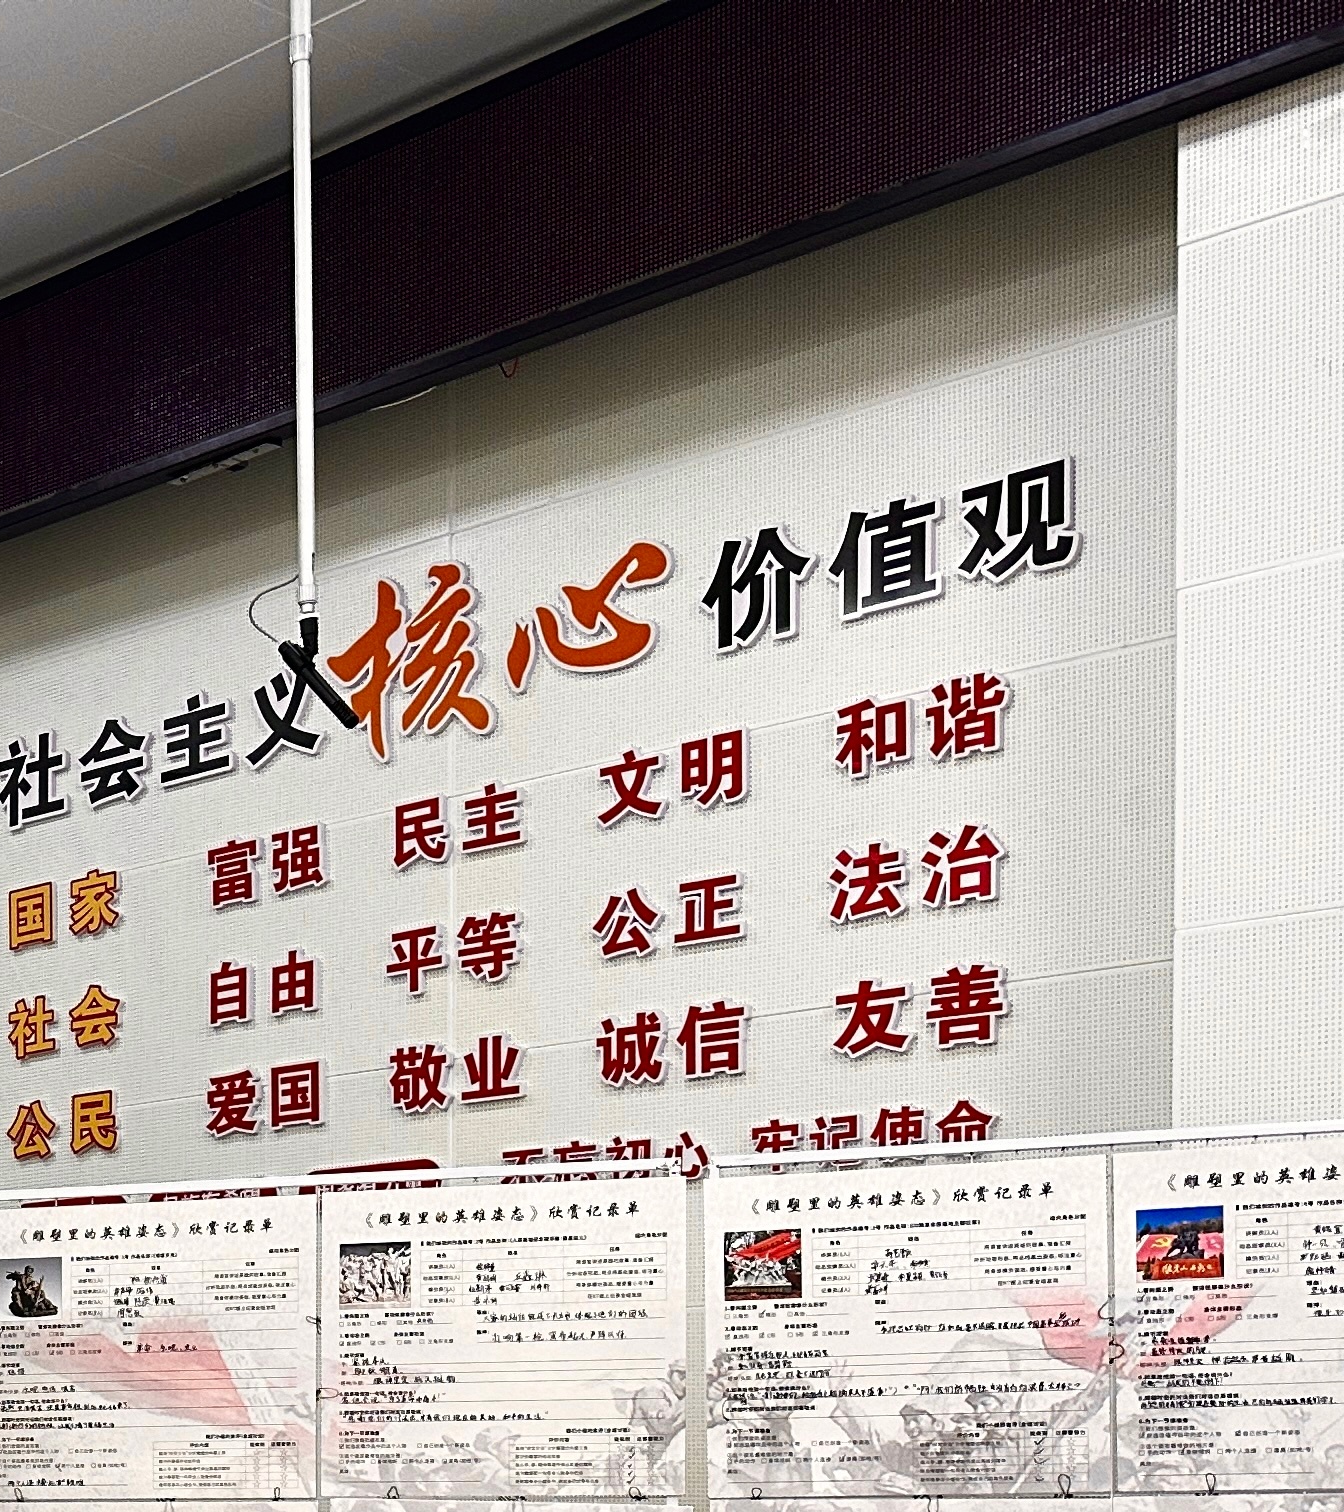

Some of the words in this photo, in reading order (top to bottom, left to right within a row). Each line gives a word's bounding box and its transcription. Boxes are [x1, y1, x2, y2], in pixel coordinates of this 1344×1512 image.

[8, 870, 120, 953] 国家
[207, 825, 325, 910] 富强
[392, 784, 523, 870] 民主
[597, 730, 747, 826] 文明
[836, 672, 1009, 778] 和谐
[8, 985, 120, 1061] 社会
[209, 949, 316, 1029] 自由
[387, 911, 518, 996] 平等
[593, 874, 743, 960] 公正
[829, 825, 1001, 923] 法治
[8, 1094, 118, 1162] 公民
[206, 1060, 322, 1139] 爱国
[389, 1037, 521, 1113] 敬业
[597, 1001, 745, 1087] 诚信
[834, 967, 1006, 1058] 友善
